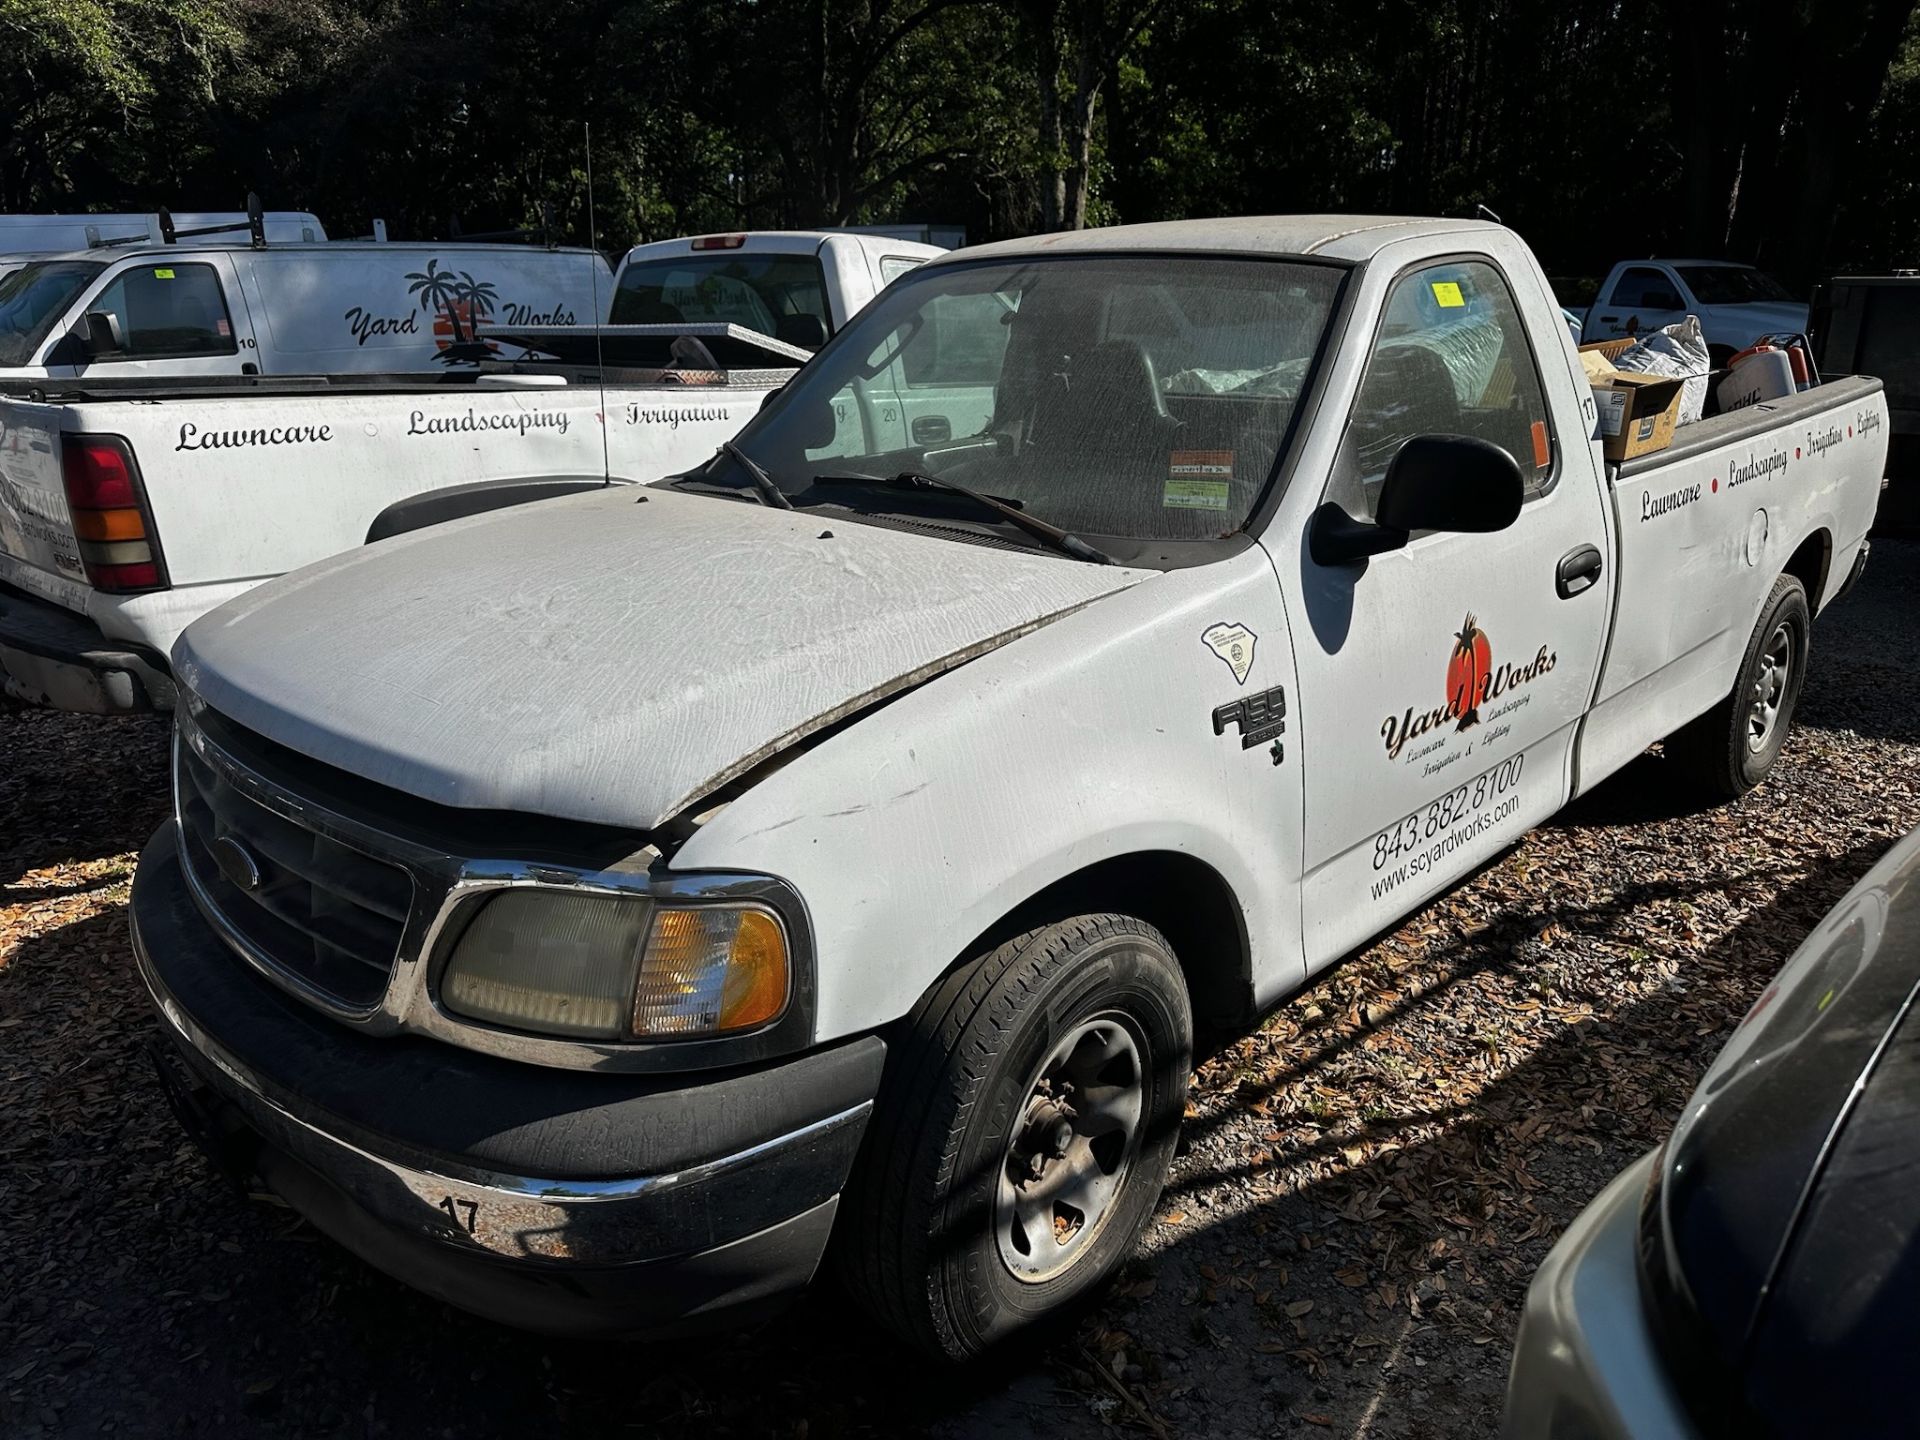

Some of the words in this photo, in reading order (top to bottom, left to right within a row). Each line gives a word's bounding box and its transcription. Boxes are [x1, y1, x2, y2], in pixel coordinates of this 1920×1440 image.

[239, 338, 256, 349] 10
[344, 307, 418, 346] Yard
[502, 303, 577, 326] Works
[175, 422, 334, 451] Lawncare
[407, 408, 571, 436] Landscaping
[626, 402, 730, 430] Irrigation
[882, 408, 897, 423] 20
[1583, 397, 1595, 420] 17
[1641, 482, 1702, 523] Lawncare
[1728, 449, 1788, 488] Landscaping
[1806, 426, 1843, 458] Irrigation
[1857, 411, 1881, 439] Lighting
[1380, 683, 1464, 760] Yard
[1479, 643, 1557, 704] Works
[1405, 737, 1446, 765] Lawncare
[1487, 693, 1531, 723] Landscaping
[1421, 751, 1461, 778] Irrigation
[1481, 723, 1511, 746] Lighting
[1373, 753, 1524, 871] 843.882.8100
[1370, 794, 1520, 900] www.scyardworks.com
[439, 1196, 478, 1234] 17
